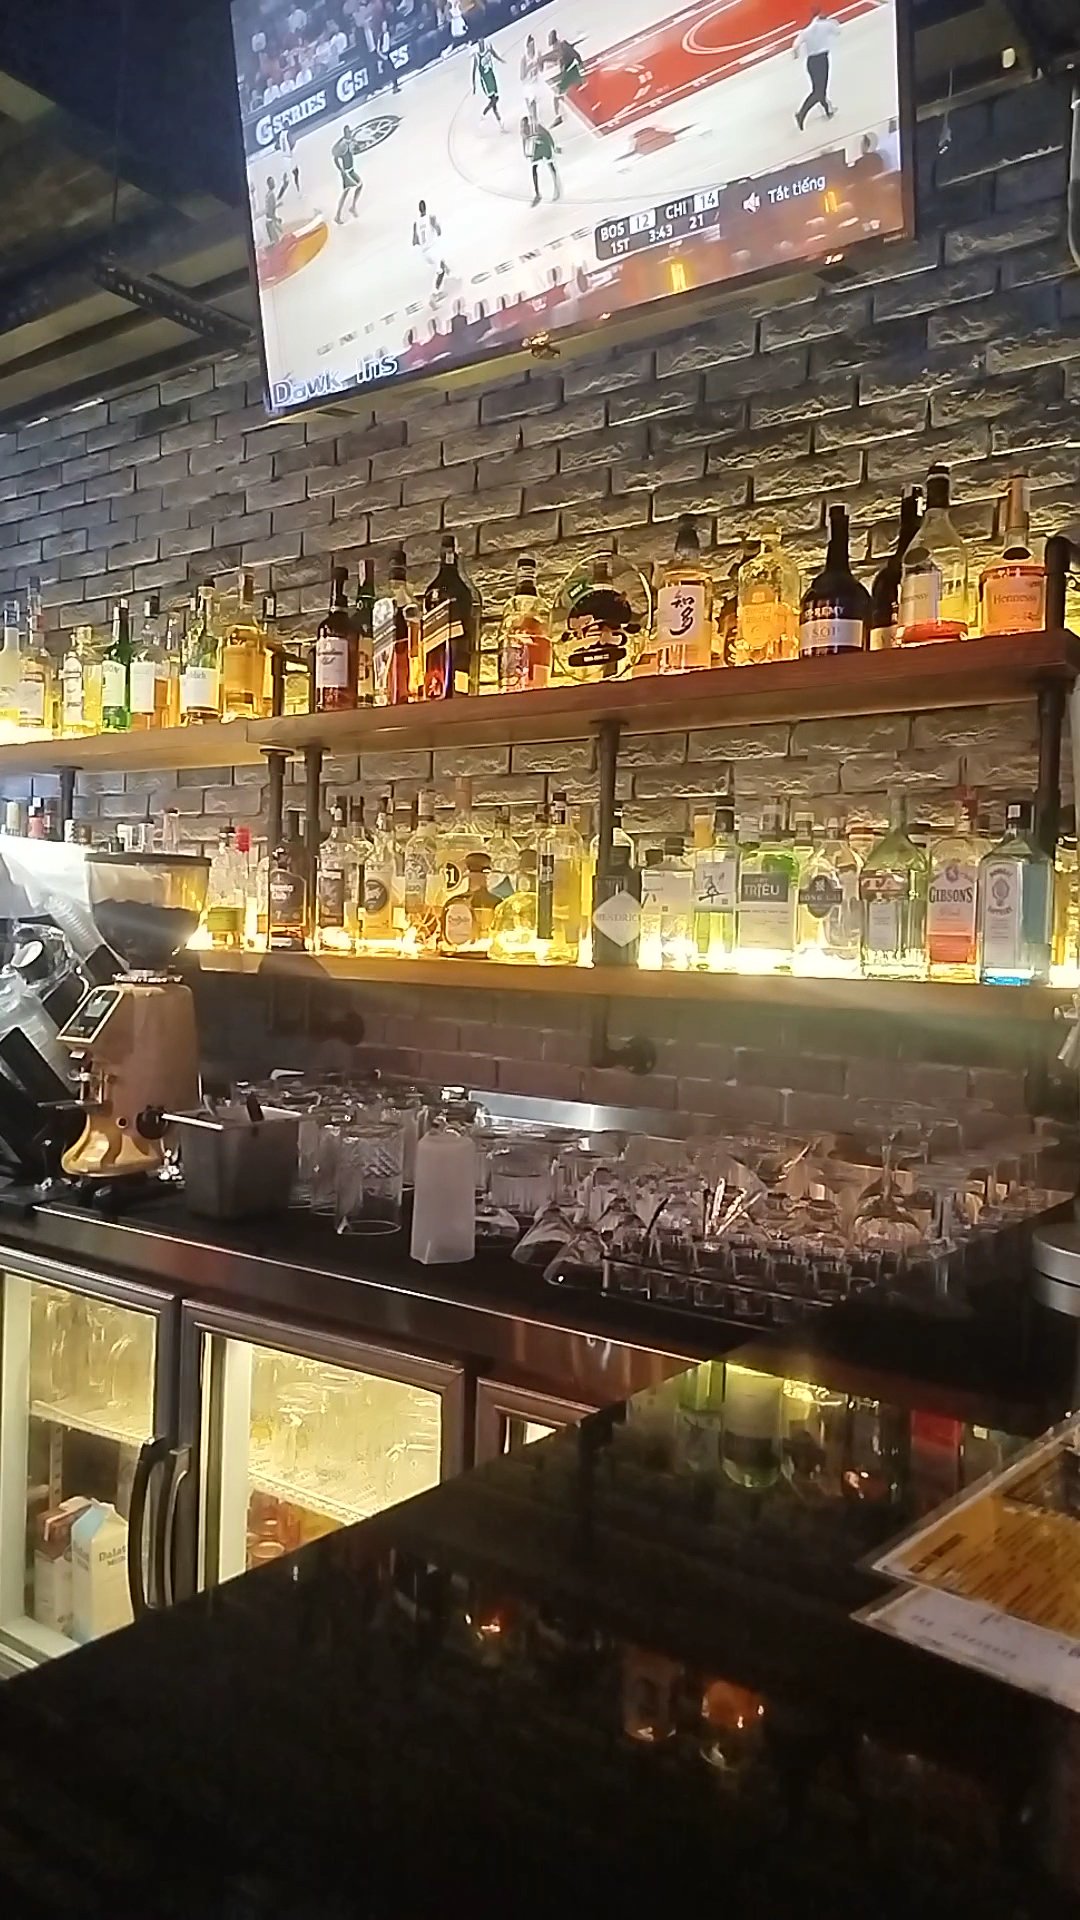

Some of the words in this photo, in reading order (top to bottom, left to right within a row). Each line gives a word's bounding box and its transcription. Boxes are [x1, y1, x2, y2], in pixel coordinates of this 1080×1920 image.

[792, 173, 826, 197] tiếng
[600, 222, 625, 242] BOS
[636, 213, 651, 230] 12
[664, 200, 687, 219] CHI
[610, 238, 630, 254] 1ST
[689, 214, 704, 230] 21
